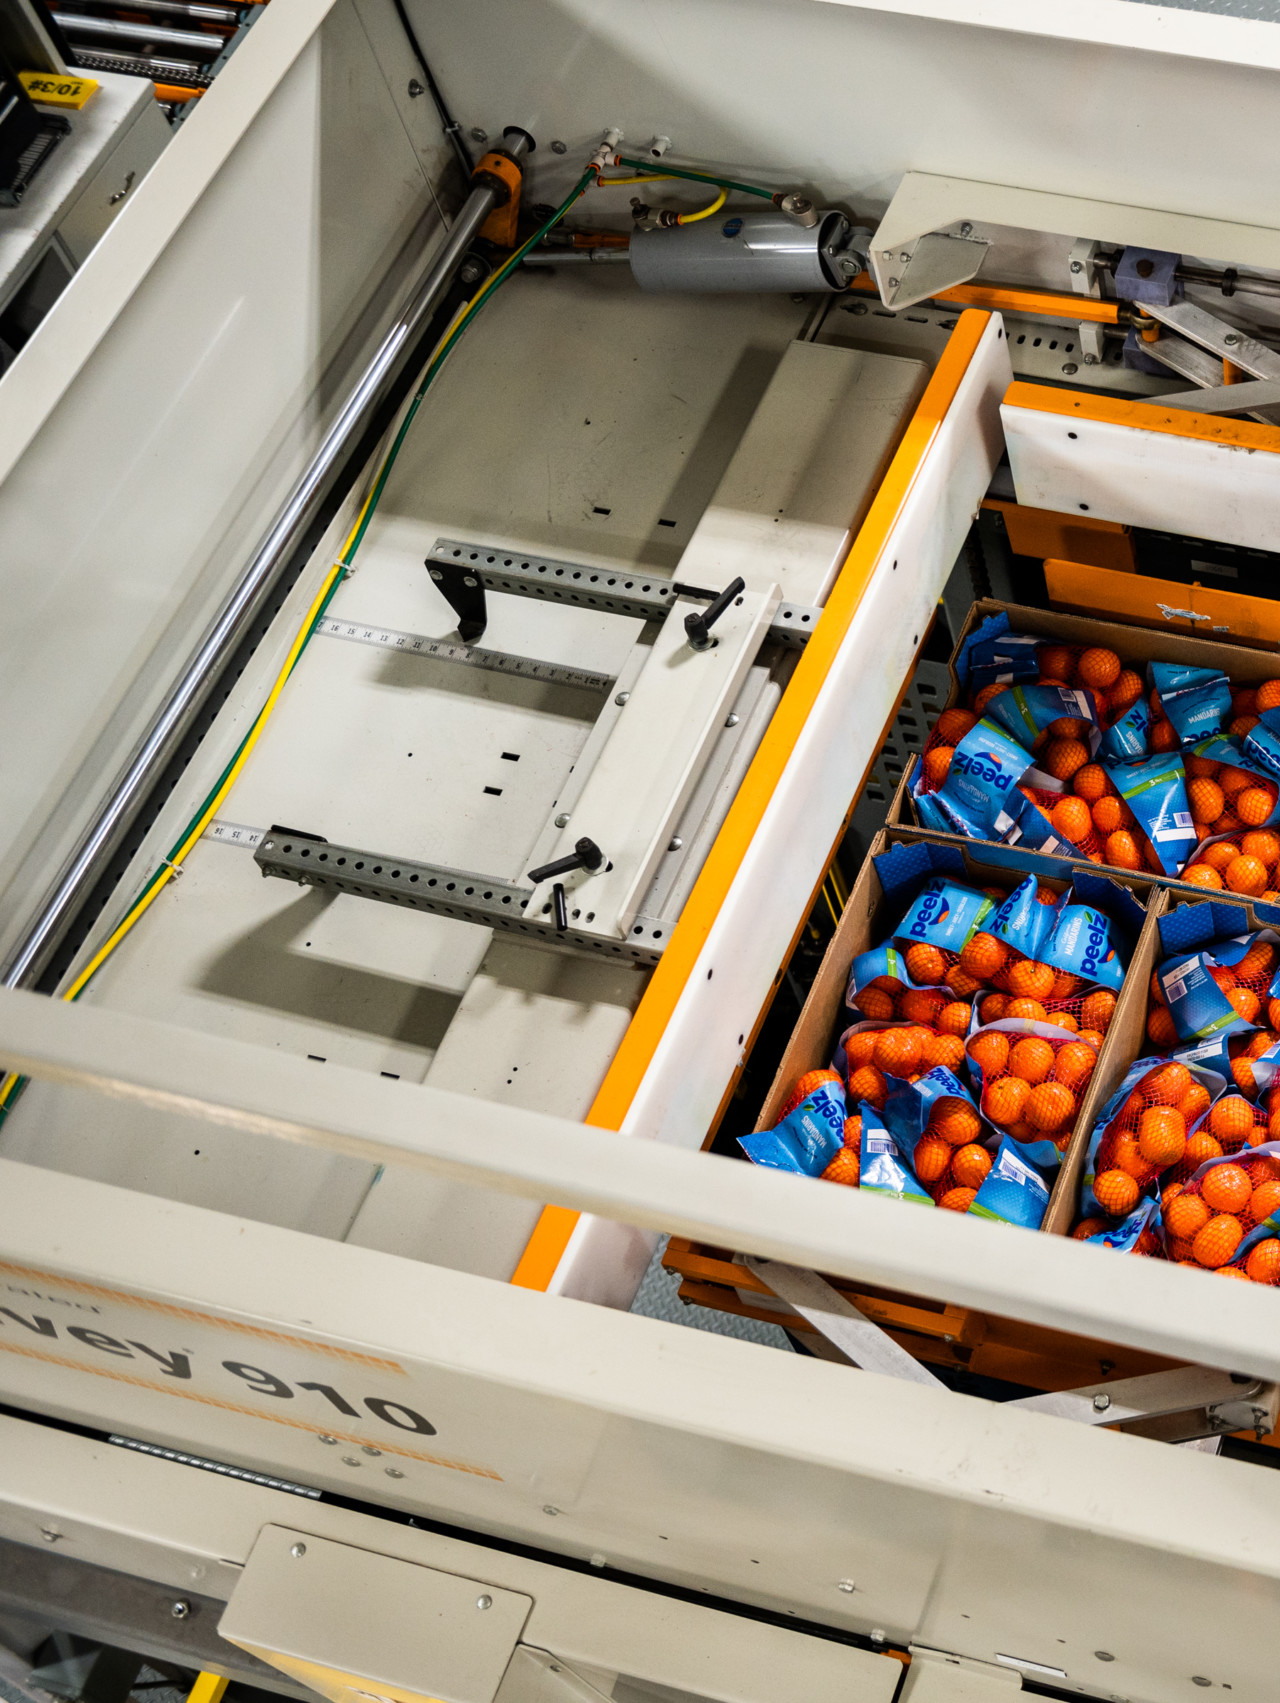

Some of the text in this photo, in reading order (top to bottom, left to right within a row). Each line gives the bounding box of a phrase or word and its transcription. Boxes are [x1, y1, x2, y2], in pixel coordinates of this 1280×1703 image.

[27, 80, 81, 96] 10/3#
[330, 624, 339, 632] 16
[380, 634, 388, 642] 13
[448, 648, 454, 656] 9
[516, 662, 521, 670] 5
[954, 751, 1013, 791] peelz
[1148, 779, 1156, 787] 3
[214, 827, 259, 842] 14 15 16
[909, 881, 947, 937] peelz
[1064, 916, 1083, 956] MANDARINS
[1080, 913, 1108, 977] peelz
[1211, 1023, 1218, 1031] 3
[801, 1115, 827, 1149] MANDARINS
[0, 1306, 438, 1436] vey 910
